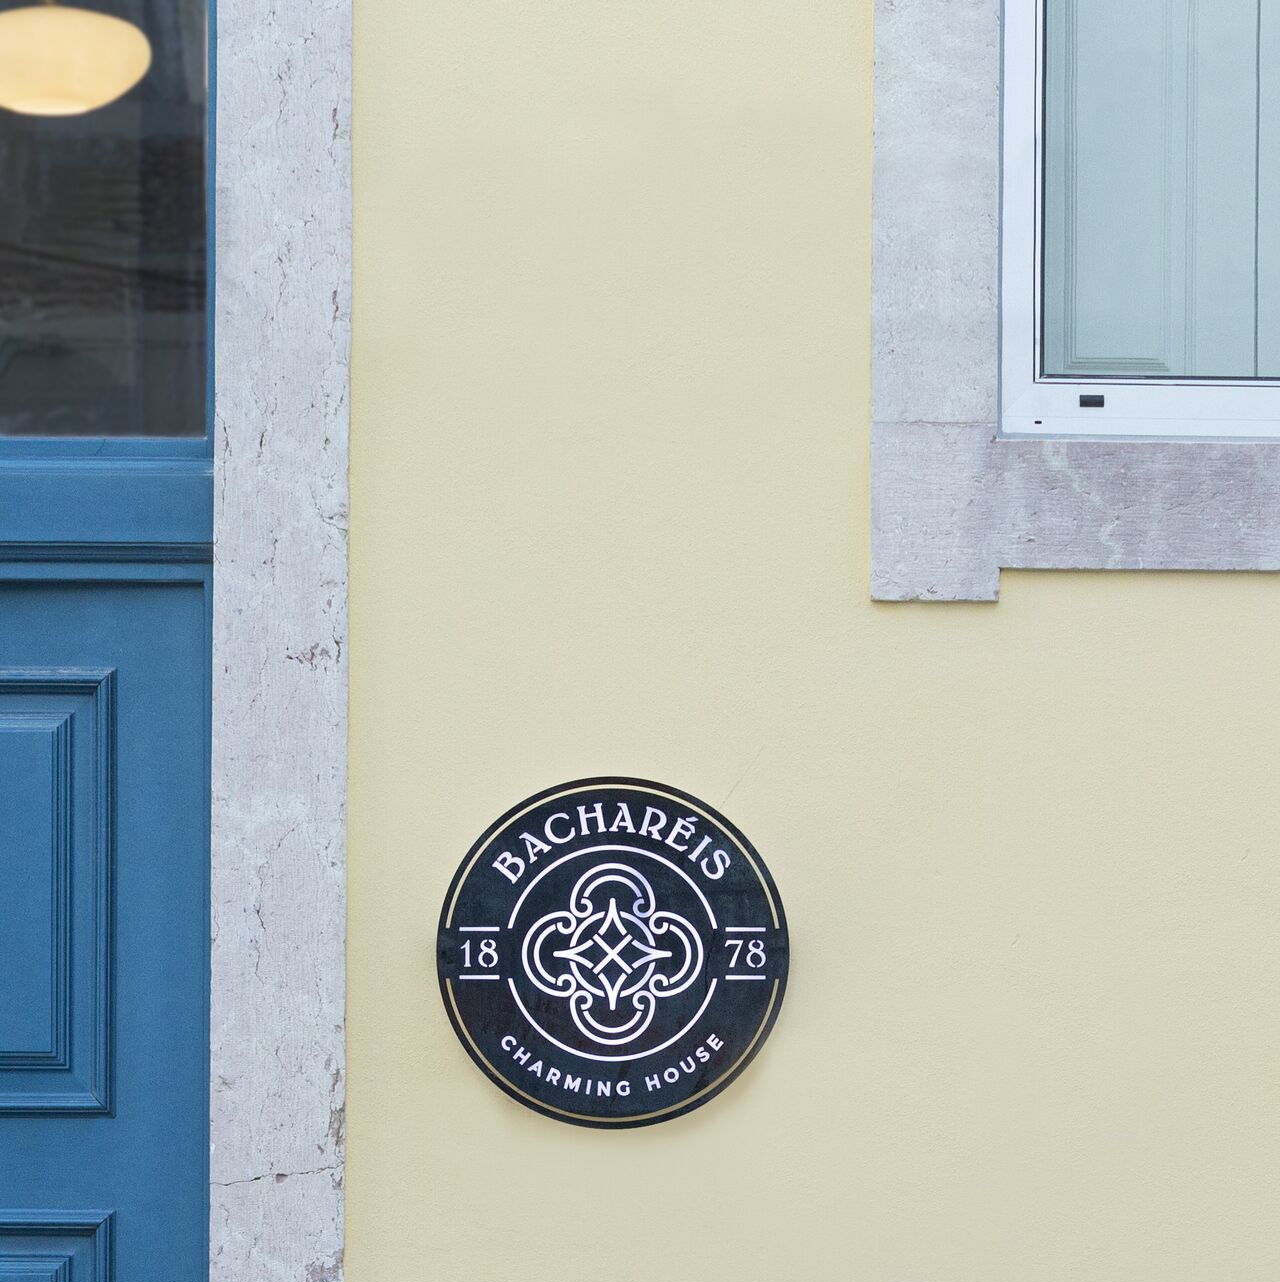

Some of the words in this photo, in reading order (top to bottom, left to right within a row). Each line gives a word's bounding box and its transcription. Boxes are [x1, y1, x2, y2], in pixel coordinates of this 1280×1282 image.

[491, 802, 732, 885] BACHARÉIS
[460, 939, 499, 968] 18
[724, 939, 767, 968] 78
[500, 1035, 632, 1097] CHARMING
[644, 1033, 725, 1092] HOUSE
